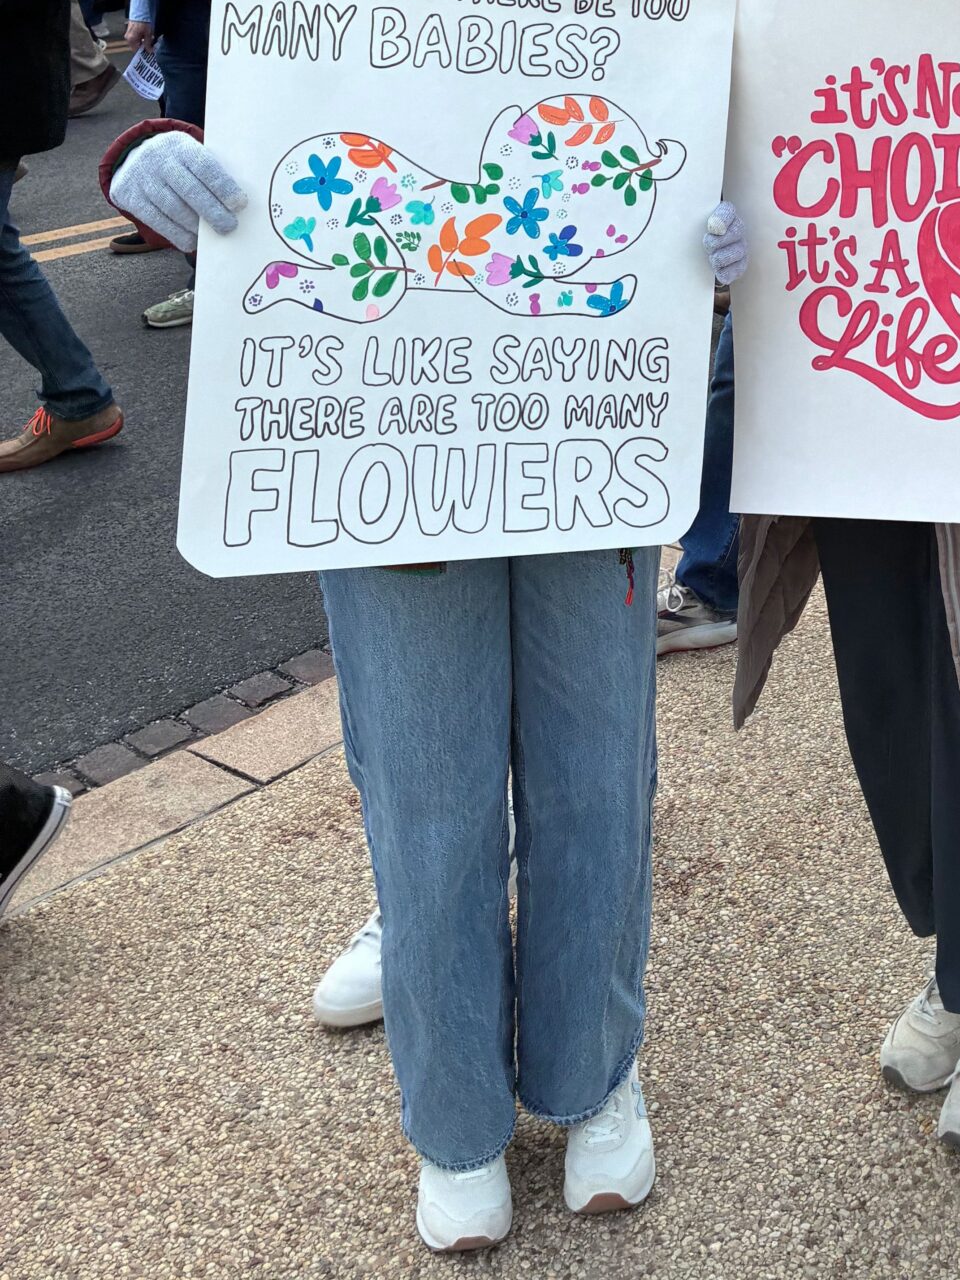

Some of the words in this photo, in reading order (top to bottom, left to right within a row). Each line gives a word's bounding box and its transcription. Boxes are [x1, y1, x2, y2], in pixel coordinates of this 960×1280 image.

[220, 0, 358, 61] MANY
[370, 6, 622, 82] BABIES?
[810, 57, 911, 130] it's
[778, 222, 859, 292] it's
[864, 228, 920, 298] A
[240, 335, 344, 388] IT'S
[362, 336, 474, 387] LIKE
[490, 335, 670, 383] SAYING
[235, 396, 364, 440] THERE
[378, 394, 458, 436] ARE
[472, 392, 548, 432] TOO
[563, 391, 669, 430] MANY
[223, 437, 672, 548] FLOWERS
